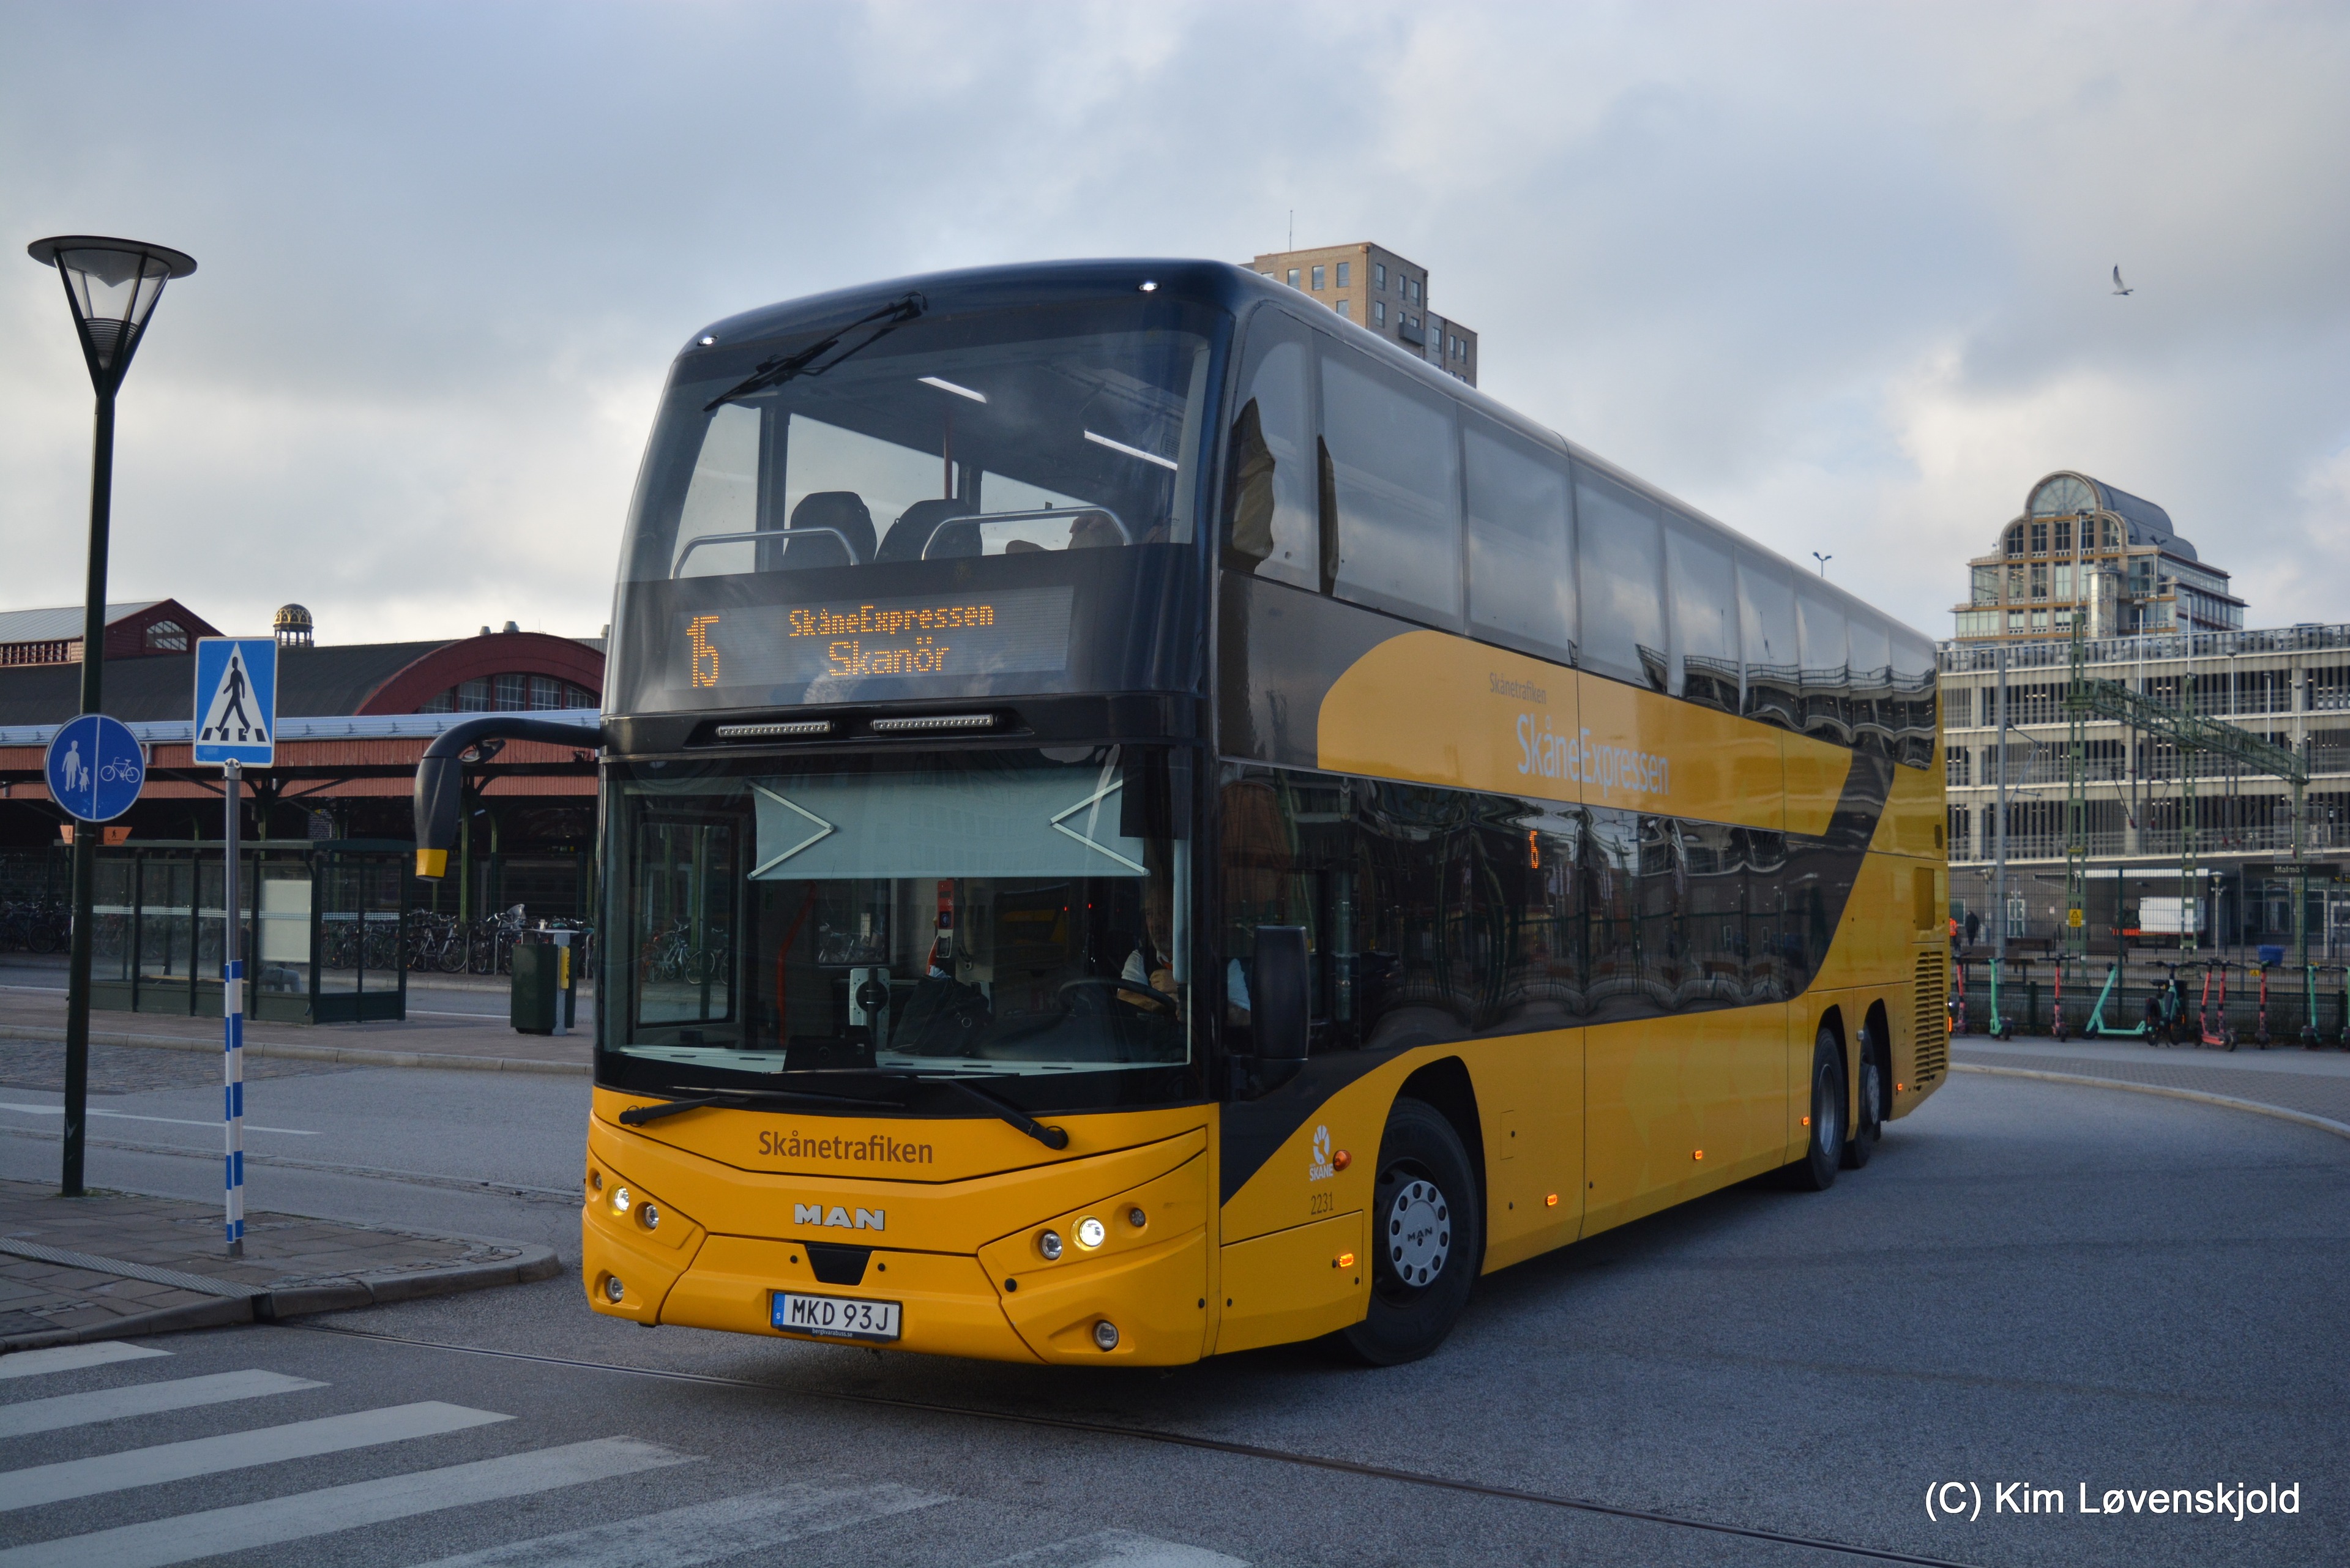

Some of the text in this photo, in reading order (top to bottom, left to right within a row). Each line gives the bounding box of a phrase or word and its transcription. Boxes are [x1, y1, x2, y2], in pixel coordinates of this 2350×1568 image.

[789, 605, 994, 637] SkåneExpressen
[687, 615, 719, 687] 15
[829, 637, 950, 676] Skanör
[1489, 671, 1547, 704] Skånetrafiken
[1516, 712, 1669, 799] SkåneExpressen
[758, 1130, 933, 1164] Skånetrafiken
[794, 1203, 886, 1231] MAN
[1311, 1191, 1334, 1215] 2231
[1407, 1226, 1433, 1242] MAN
[791, 1298, 889, 1331] MKD 93J
[811, 1327, 853, 1338] bergkvarabuss.se
